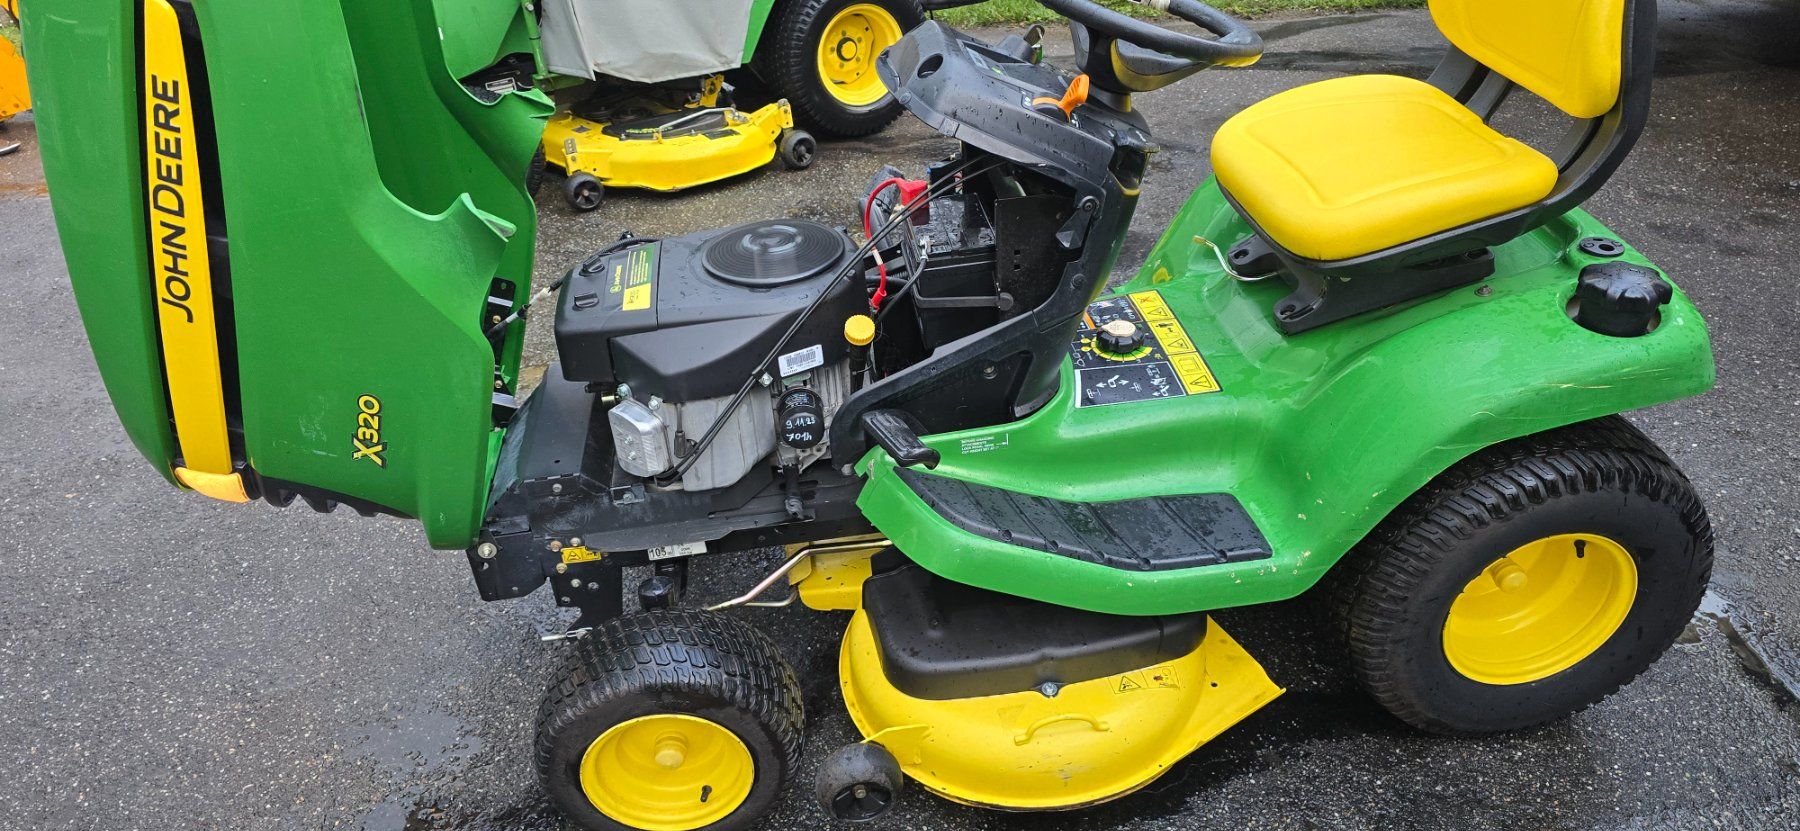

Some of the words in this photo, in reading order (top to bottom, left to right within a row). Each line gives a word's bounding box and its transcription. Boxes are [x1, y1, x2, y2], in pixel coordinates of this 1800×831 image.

[151, 74, 185, 218] DEERE
[160, 220, 194, 324] JOHN
[352, 394, 387, 468] X320
